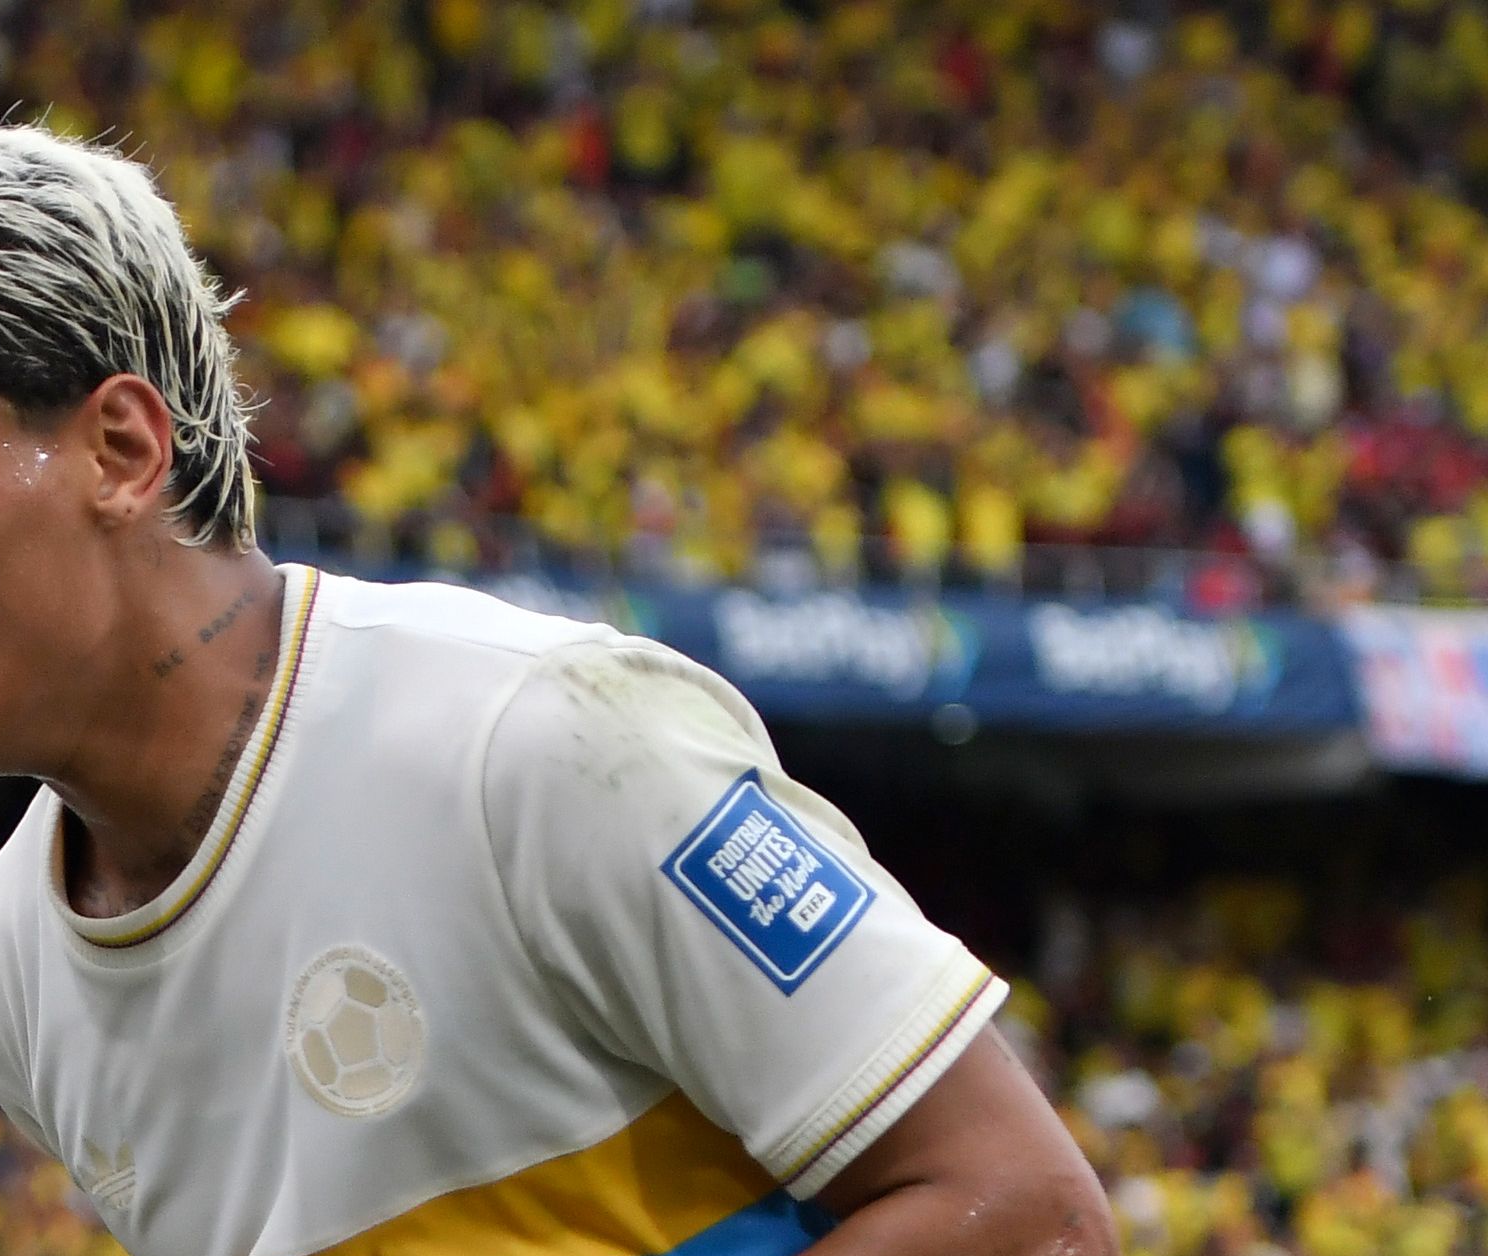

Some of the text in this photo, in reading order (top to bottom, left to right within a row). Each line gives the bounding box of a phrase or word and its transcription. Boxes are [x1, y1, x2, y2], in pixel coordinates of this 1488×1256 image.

[706, 810, 773, 880] FOOTBALL
[725, 826, 799, 902] UNITES
[748, 893, 786, 927] the
[798, 892, 828, 923] FIFA
